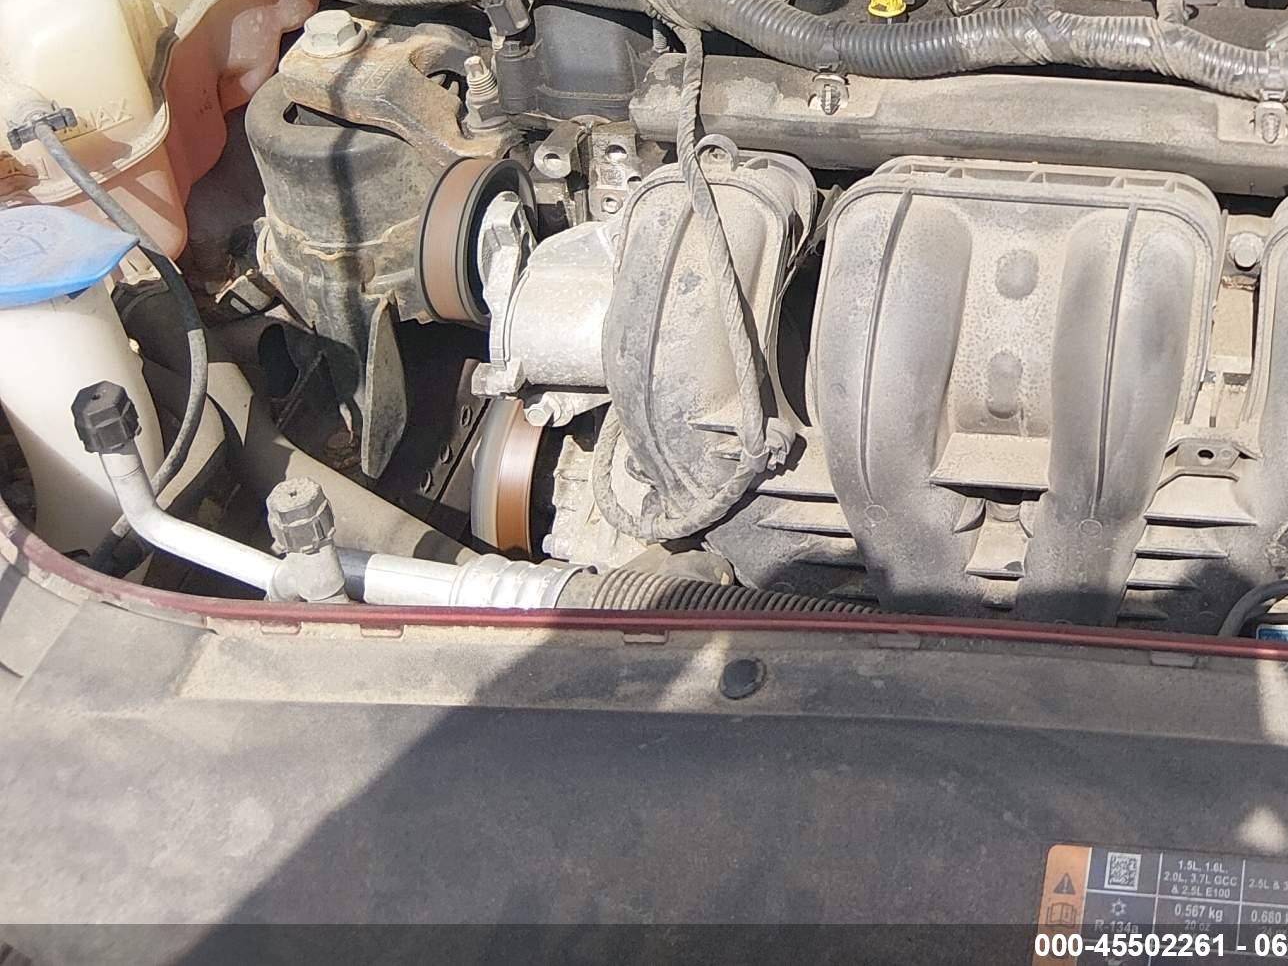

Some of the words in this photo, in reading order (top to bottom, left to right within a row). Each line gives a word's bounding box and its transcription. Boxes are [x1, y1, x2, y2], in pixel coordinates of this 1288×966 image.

[1163, 871, 1188, 883] 2.0L,
[1190, 873, 1212, 885] 3.7L
[1214, 875, 1238, 887] GCC
[1248, 878, 1270, 890] 2.5L
[1181, 885, 1203, 896] 2.5L
[1205, 887, 1231, 899] E100
[1174, 903, 1207, 919] 0.567
[1208, 906, 1224, 923] kg
[1250, 909, 1282, 925] 0.680
